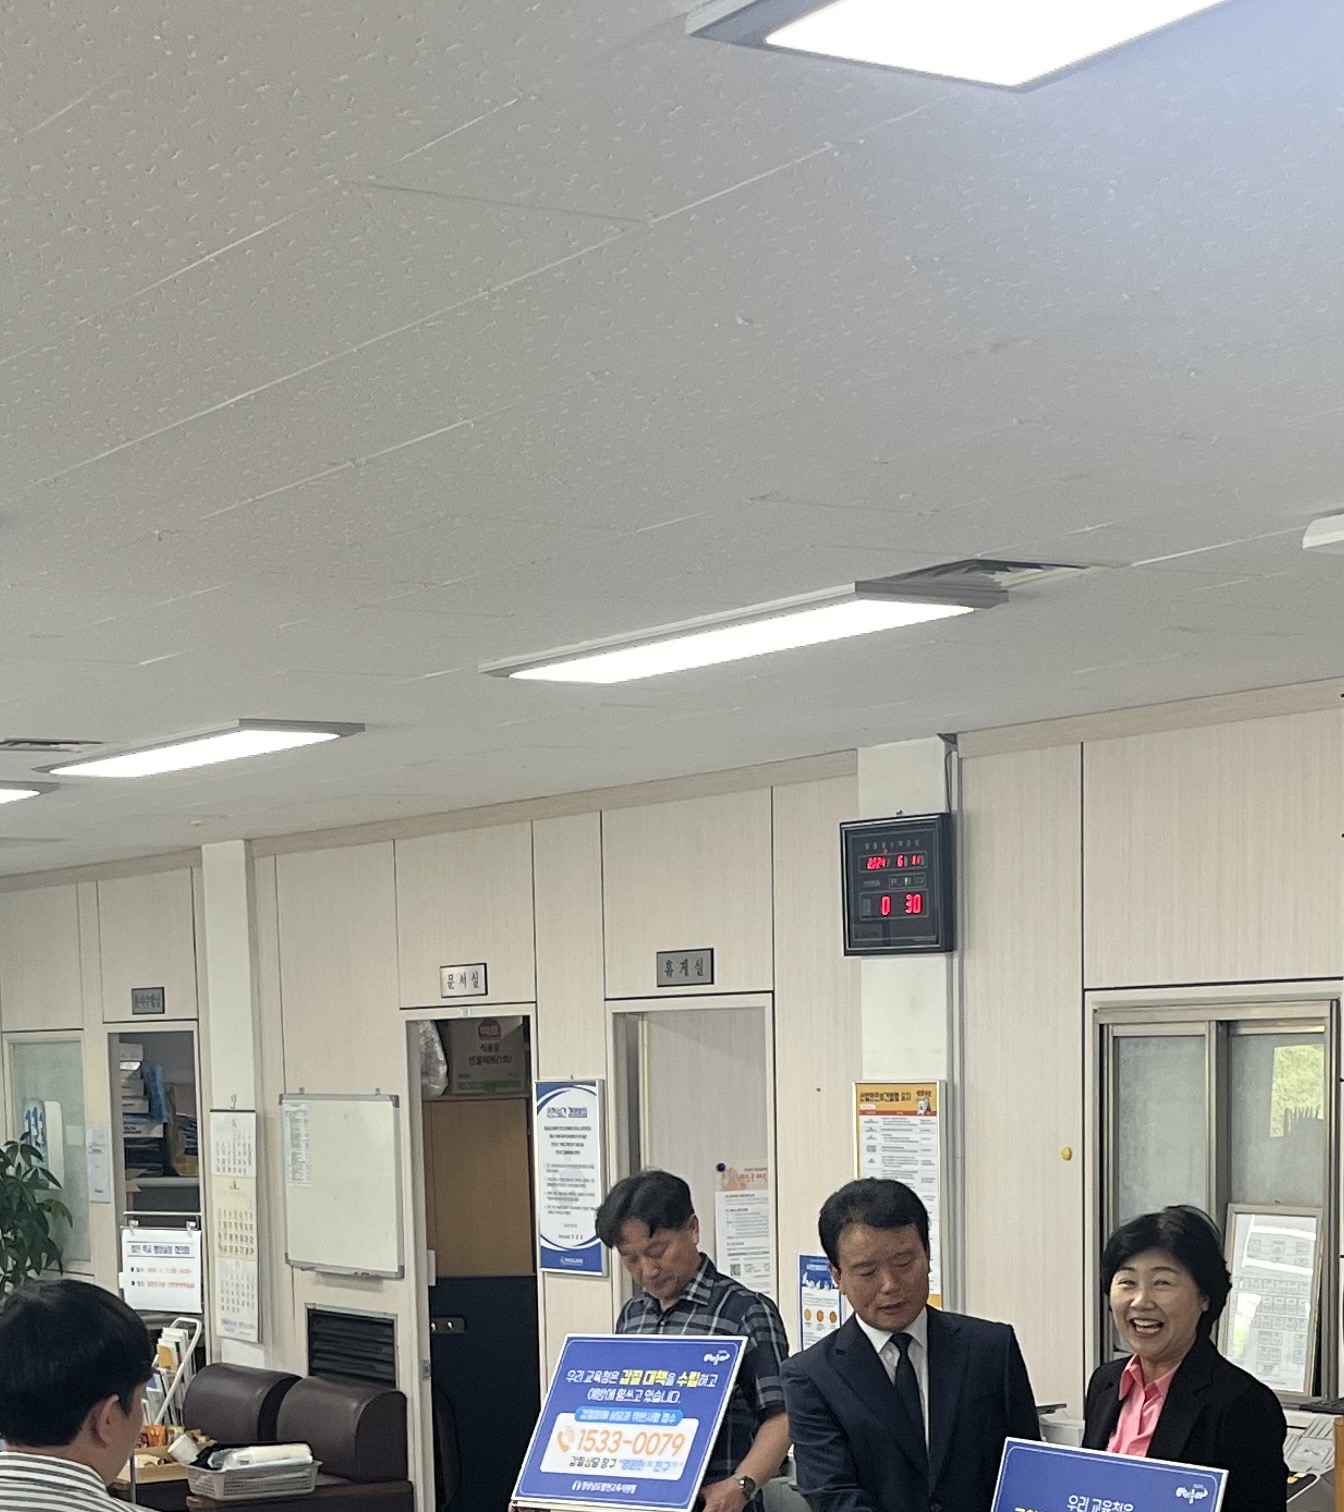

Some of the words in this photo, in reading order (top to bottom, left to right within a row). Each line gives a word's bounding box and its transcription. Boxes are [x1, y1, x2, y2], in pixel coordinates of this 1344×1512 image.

[905, 893, 922, 914] 30
[663, 957, 704, 978] 휴게실
[446, 970, 480, 990] 문서실
[566, 1370, 584, 1383] 우리
[584, 1370, 620, 1385] 교육청은
[576, 1428, 685, 1456] 1533-0079
[1067, 1494, 1088, 1512] 우리
